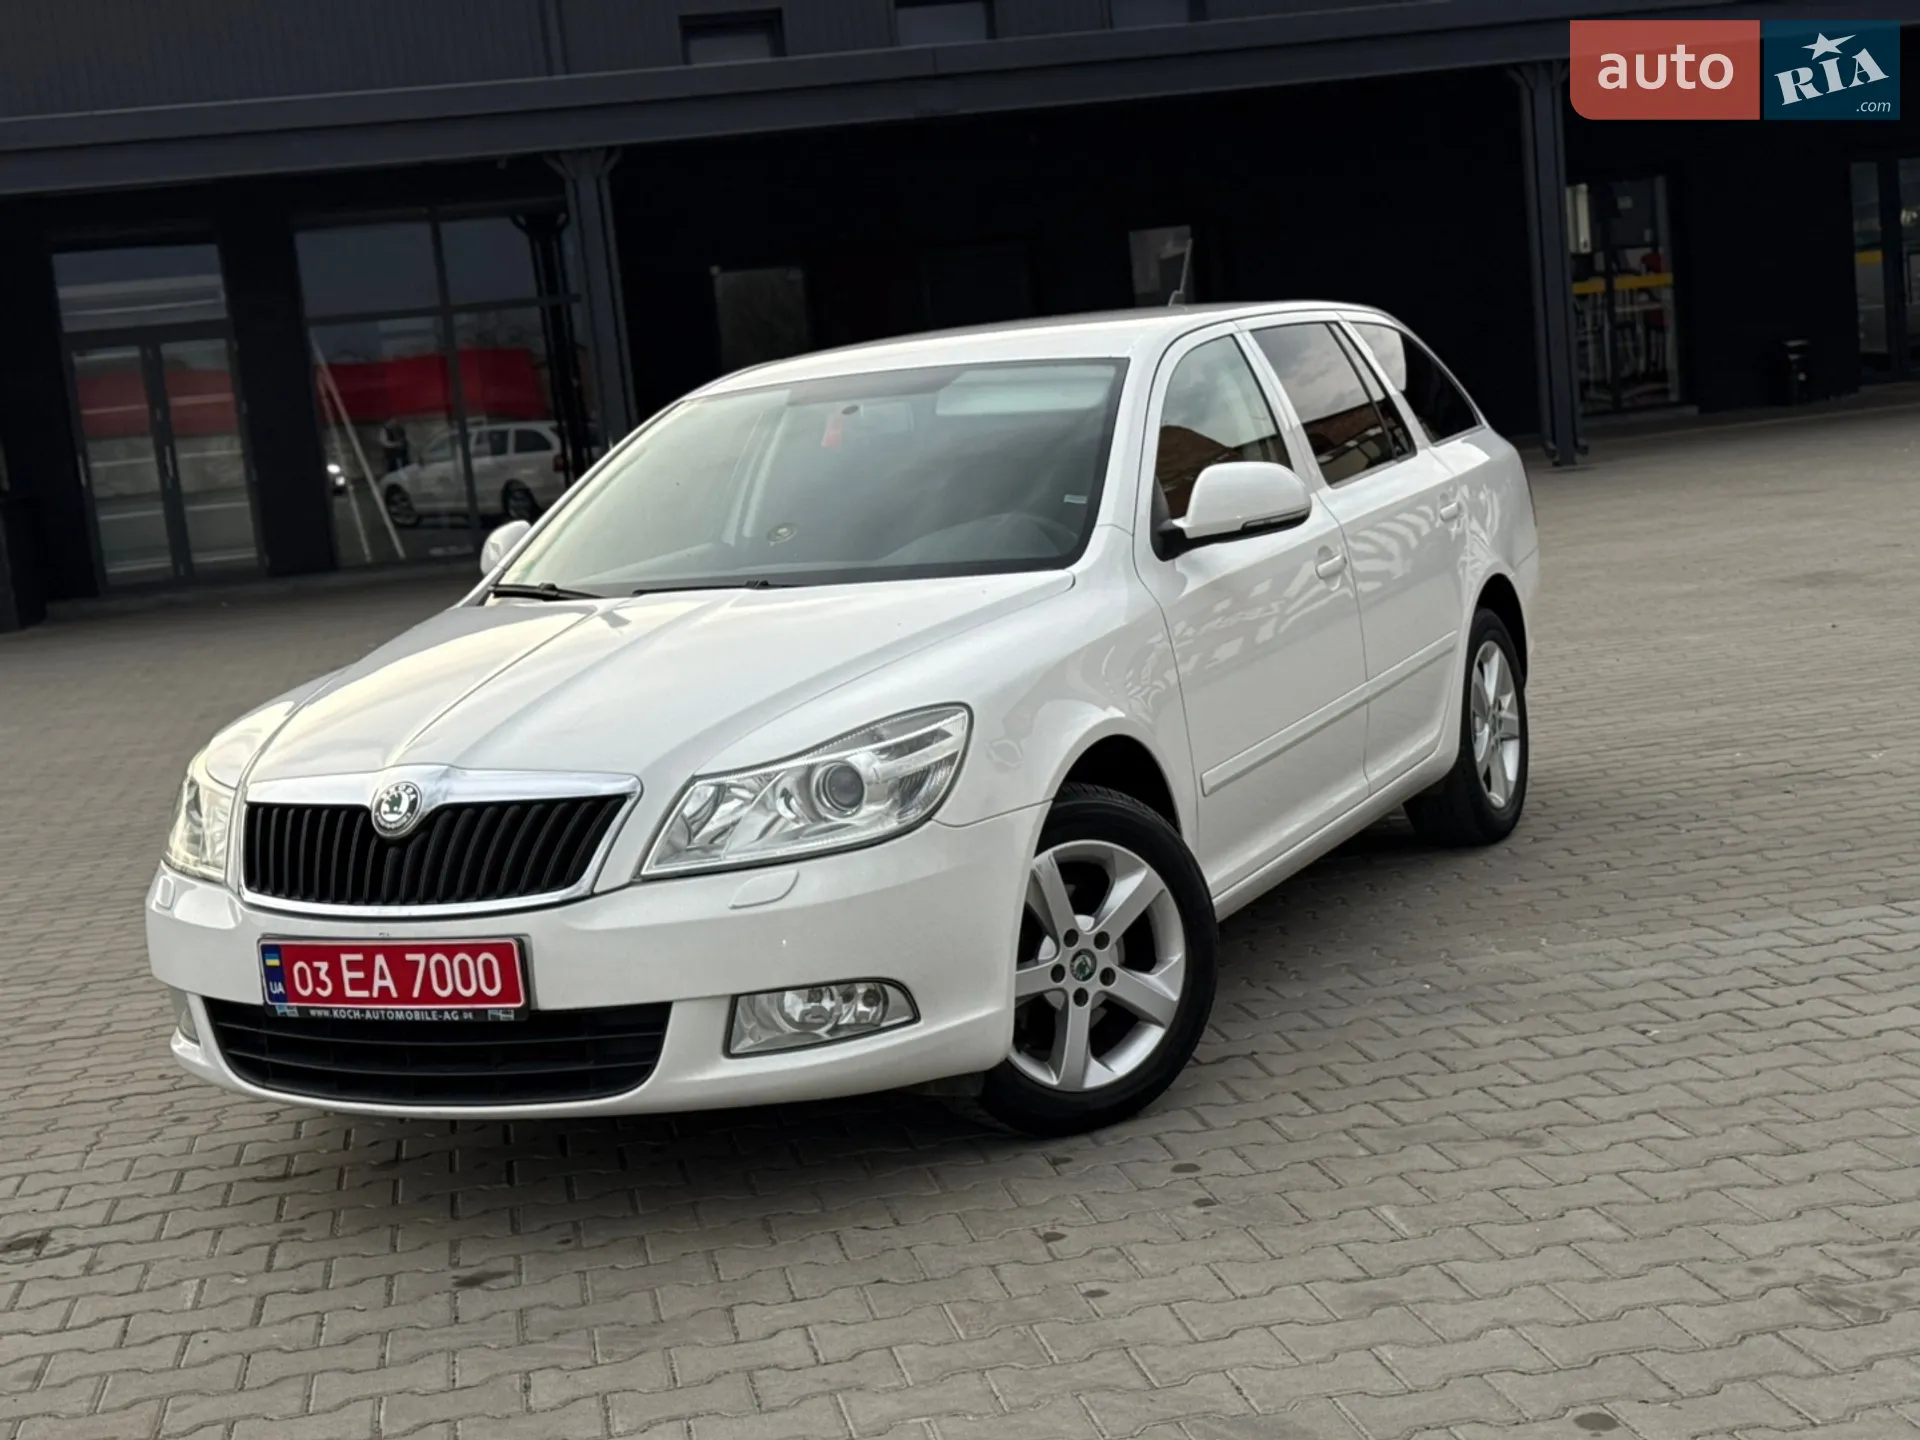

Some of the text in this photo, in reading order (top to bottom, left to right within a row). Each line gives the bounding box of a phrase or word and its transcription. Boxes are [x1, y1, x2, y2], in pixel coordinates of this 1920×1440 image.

[269, 981, 286, 995] UA
[293, 952, 502, 998] 03 EA 7000
